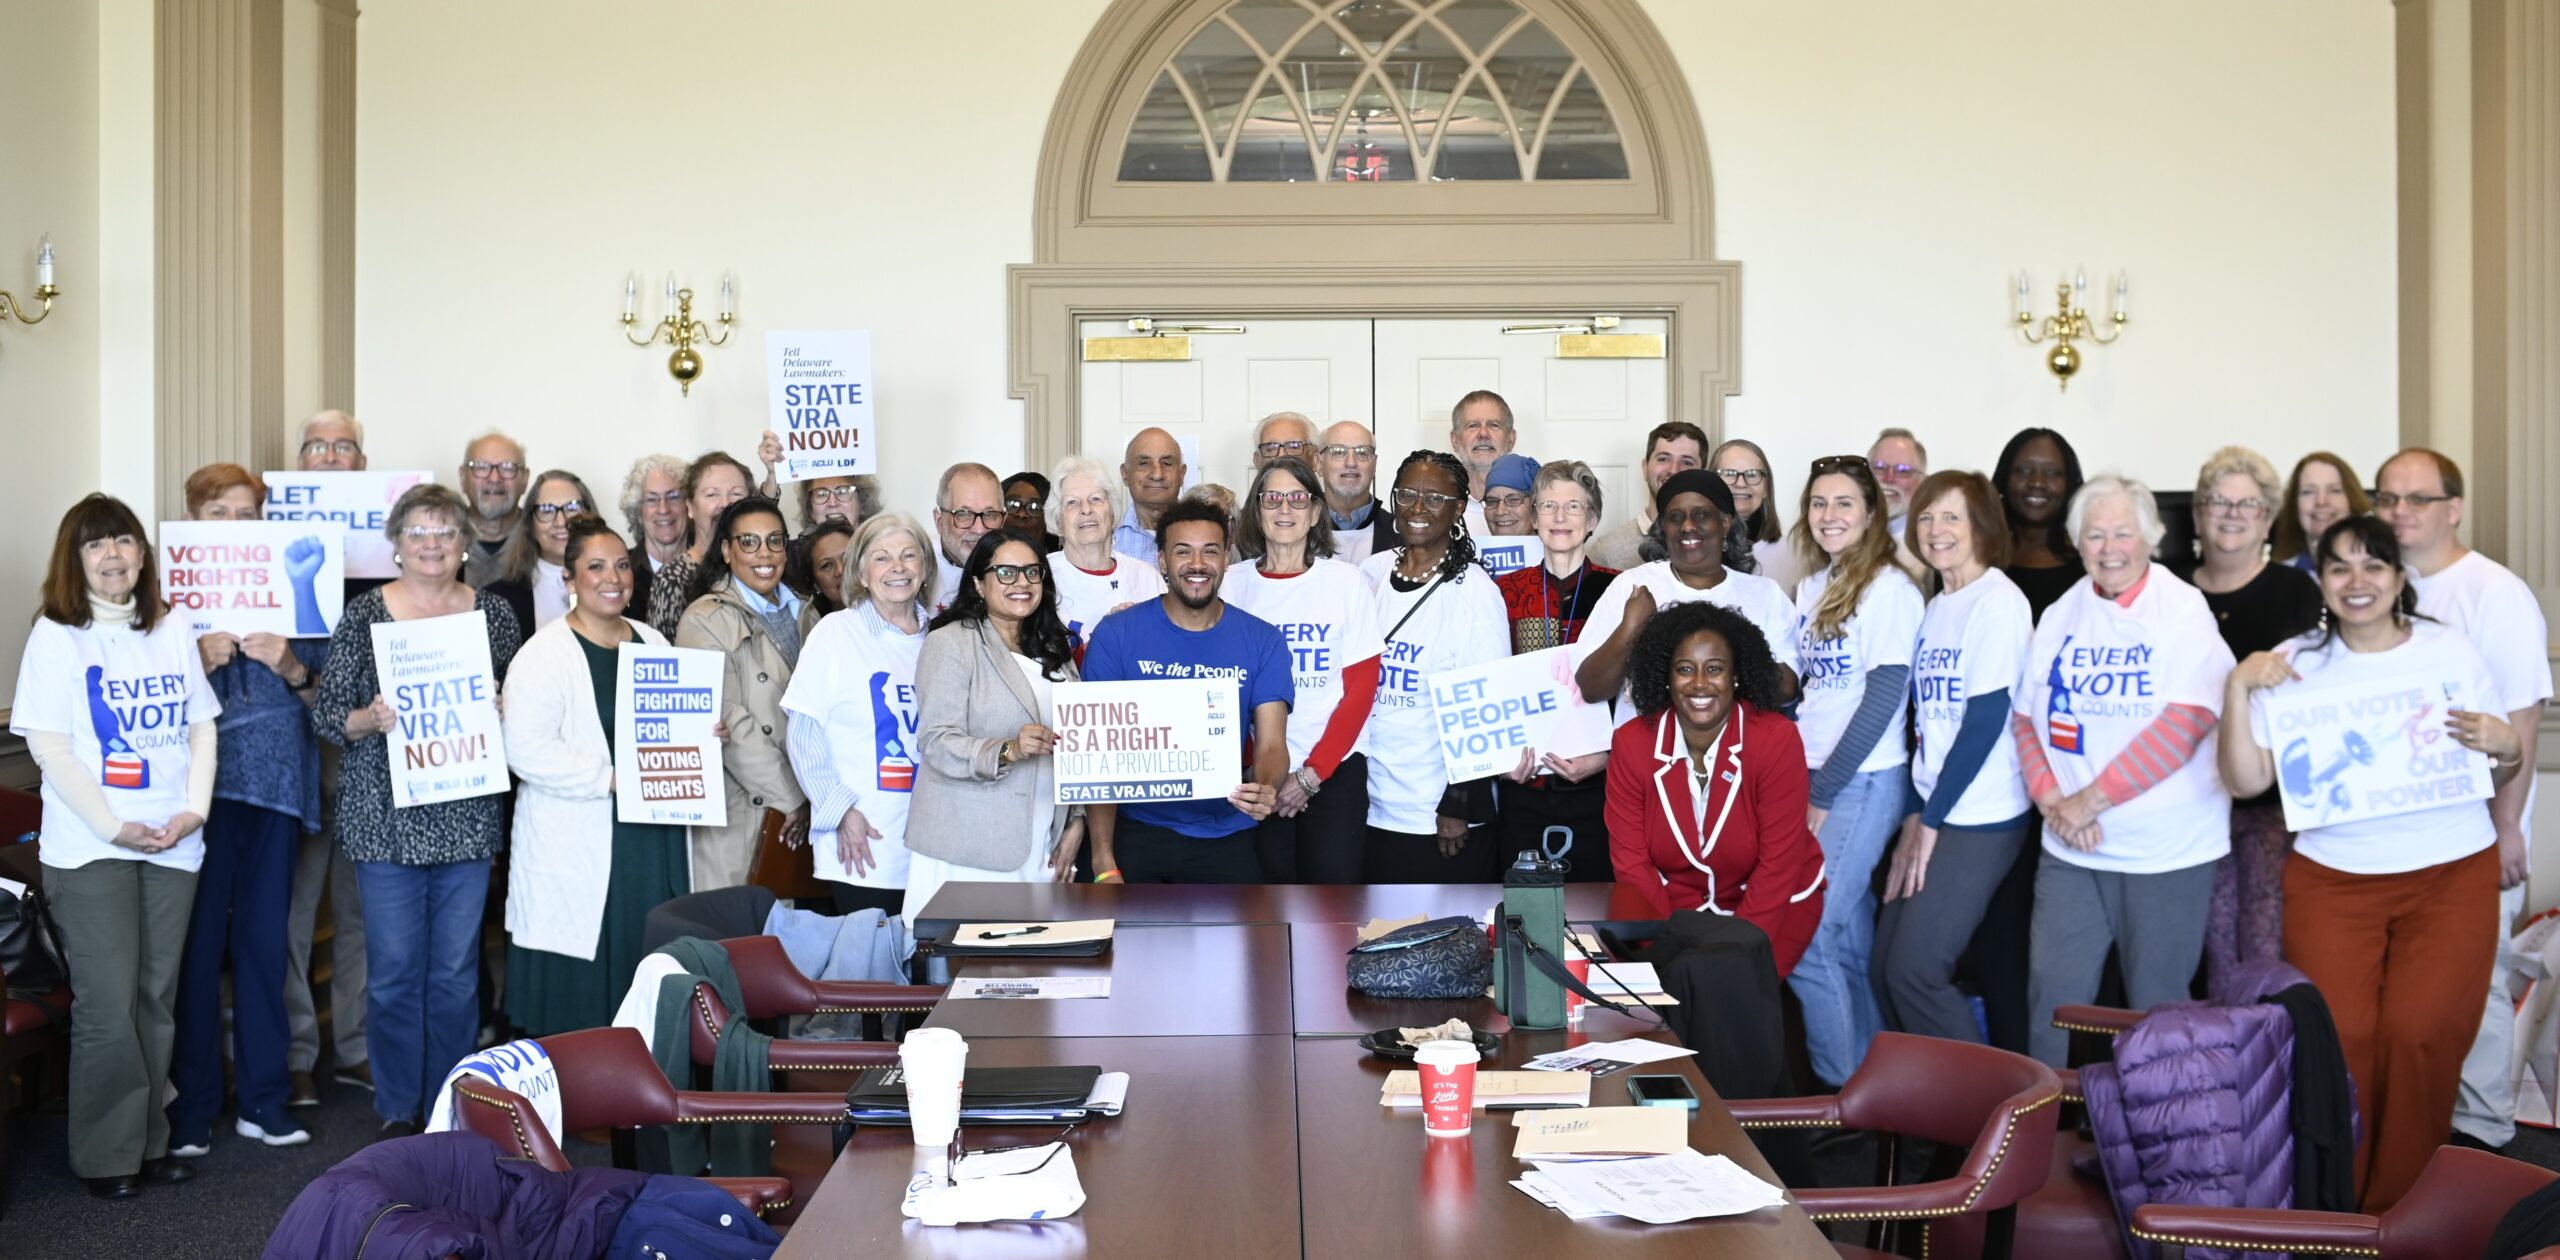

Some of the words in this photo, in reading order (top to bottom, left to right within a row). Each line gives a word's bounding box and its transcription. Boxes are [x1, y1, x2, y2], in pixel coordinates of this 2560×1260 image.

[783, 347, 800, 357] Tell
[783, 358, 832, 368] Delaware
[783, 368, 846, 378] Lawmakers:
[785, 383, 863, 406] STATE
[786, 407, 841, 430] VRA
[788, 428, 859, 452] NOW!
[811, 459, 834, 468] ACLU
[837, 458, 857, 467] LDF
[267, 486, 321, 505] LET
[167, 545, 272, 564] VOTING
[1483, 550, 1524, 569] STILL
[168, 568, 269, 587] RIGHTS
[169, 591, 222, 609] FOR
[231, 590, 282, 608] ALL
[1280, 623, 1331, 642] ERY
[389, 639, 408, 652] Tell
[2072, 643, 2153, 667] EVERY
[390, 649, 447, 665] Delaware
[1293, 648, 1330, 672] TE
[634, 663, 678, 681] STILL
[1137, 659, 1164, 676] We
[1165, 662, 1191, 678] the
[1194, 664, 1248, 681] People
[107, 673, 186, 700] EVERY
[396, 674, 486, 712] STATE
[1434, 677, 1488, 708] LET
[2072, 671, 2154, 696] VOTE
[635, 692, 712, 711] FIGHTING
[2081, 700, 2153, 718] COUNTS
[2277, 704, 2341, 732] OUR
[2344, 687, 2425, 719] VOTE
[1057, 702, 1139, 727] VOTING
[1207, 712, 1225, 720] ACLU
[1440, 689, 1557, 734] PEOPLE
[399, 709, 464, 741] VRA
[636, 722, 669, 740] FOR
[1208, 727, 1226, 736] LDF
[1059, 729, 1080, 752] IS
[1085, 728, 1100, 752] A
[1106, 726, 1179, 752] RIGHT.
[1445, 724, 1527, 760] VOTE
[404, 733, 488, 770] NOW!
[638, 751, 701, 769] VOTING
[1059, 753, 1094, 775] NOT
[1099, 752, 1111, 775] A
[1116, 750, 1215, 774] PRIVILEGDE.
[2407, 748, 2471, 777] OUR
[642, 780, 705, 799] RIGHTS
[1060, 785, 1110, 800] STATE
[1113, 783, 1144, 798] VRA
[1149, 782, 1192, 796] NOW.
[2366, 773, 2477, 811] POWER
[1430, 1089, 1460, 1104] Little
